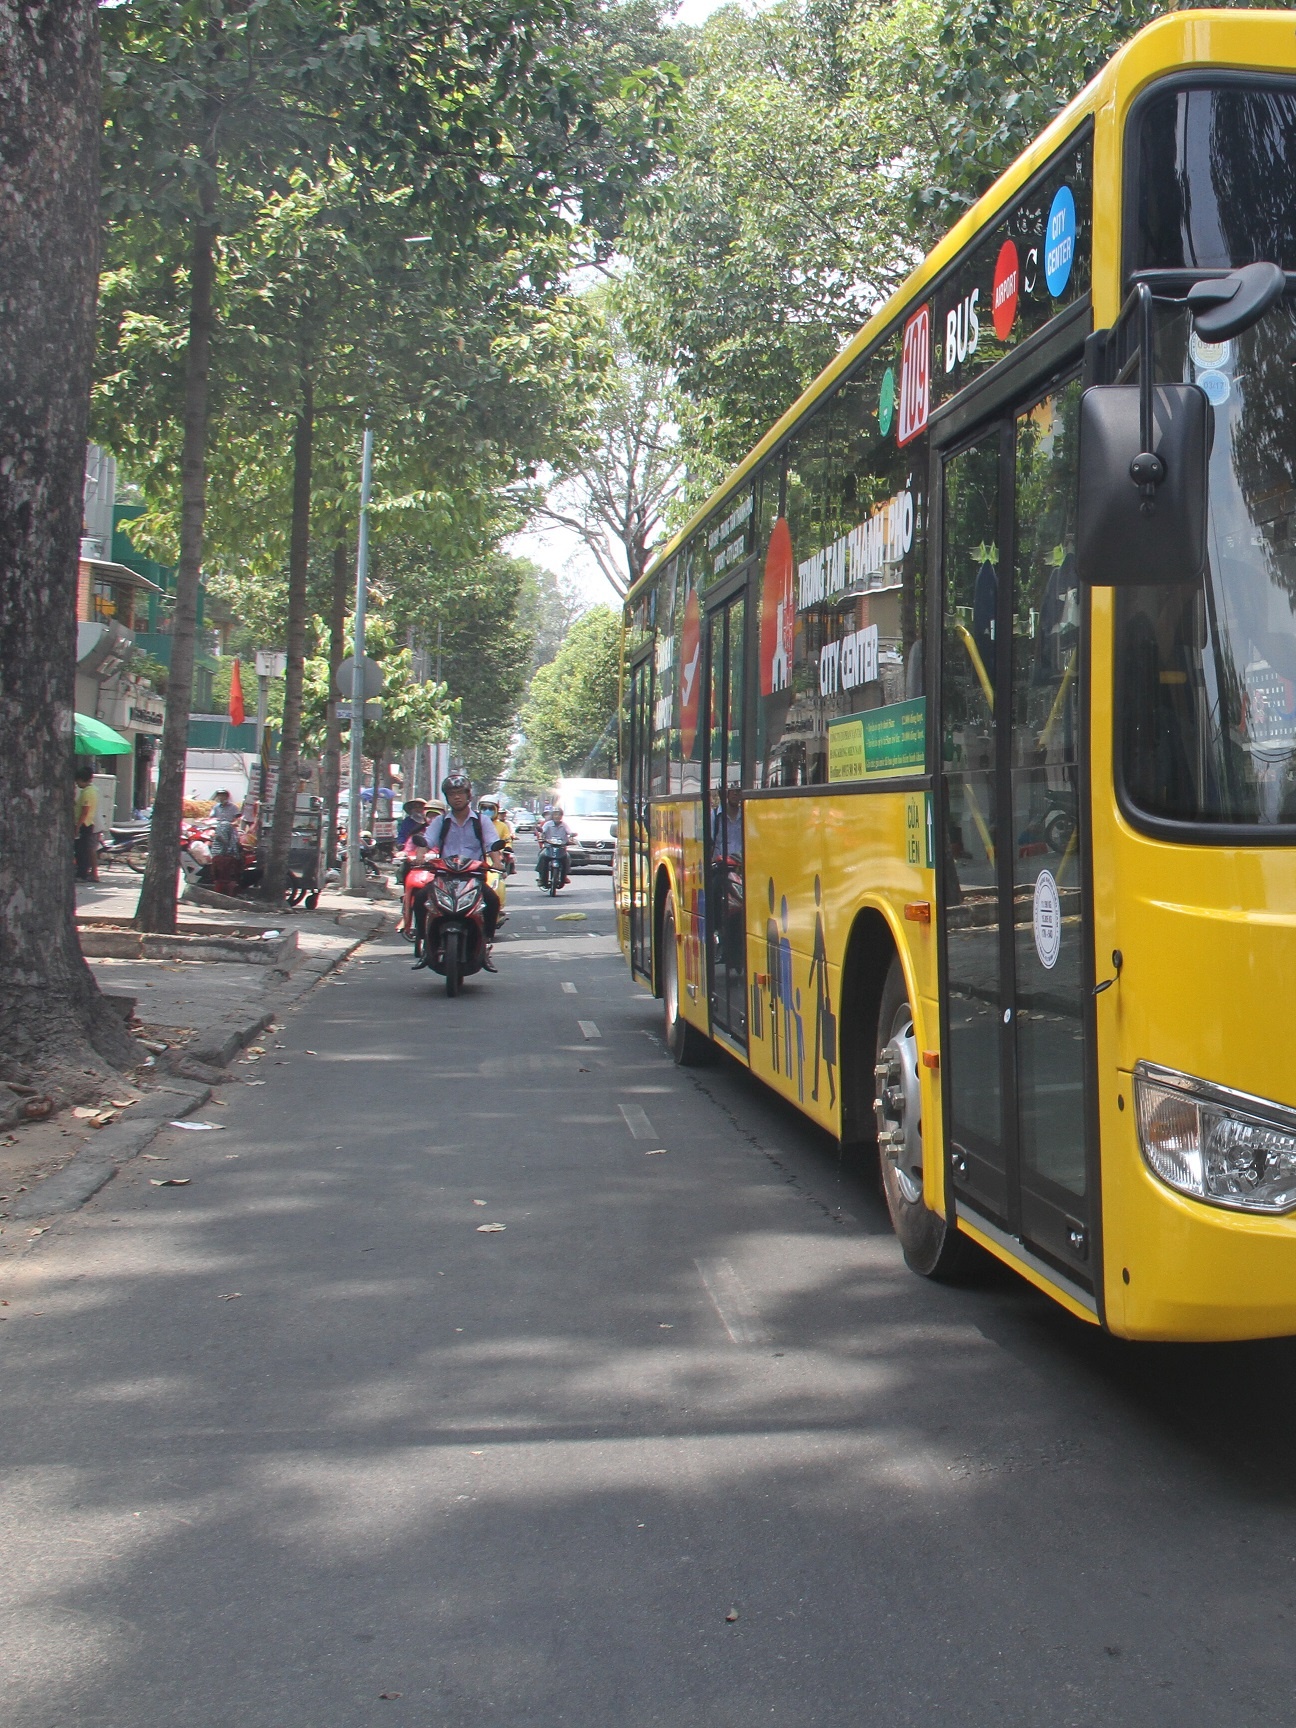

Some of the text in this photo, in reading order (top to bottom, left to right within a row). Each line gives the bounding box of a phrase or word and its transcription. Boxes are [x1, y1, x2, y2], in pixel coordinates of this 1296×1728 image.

[1052, 208, 1066, 239] CITY
[1047, 237, 1073, 276] CENTER
[995, 270, 1017, 309] AIRPORT
[945, 288, 980, 374] BUS
[904, 310, 930, 434] 109
[798, 549, 825, 611] TRUNG
[826, 531, 847, 597] TÂM
[849, 511, 885, 584] THÀNH
[888, 472, 913, 565] PHỐ
[821, 623, 879, 697] CITY CENTER
[907, 797, 920, 829] CỬA
[908, 834, 921, 864] LÊN
